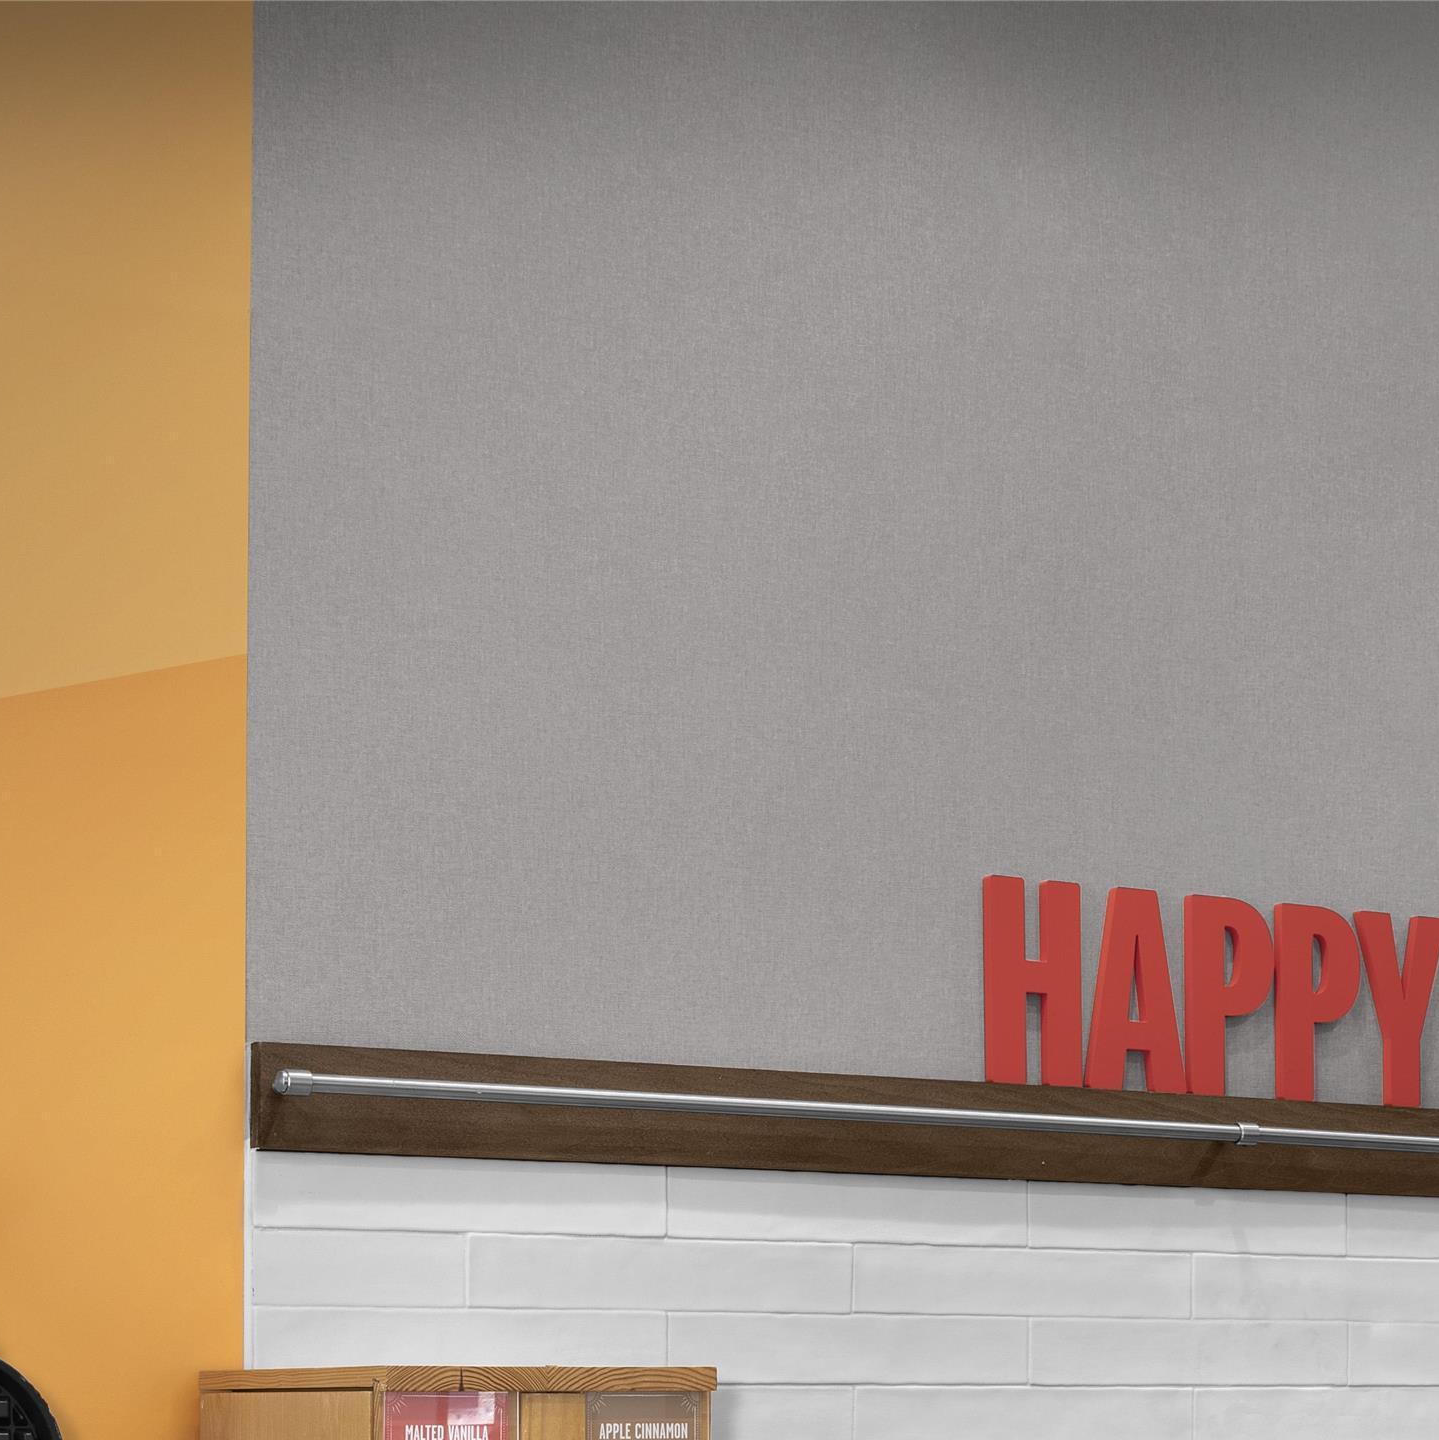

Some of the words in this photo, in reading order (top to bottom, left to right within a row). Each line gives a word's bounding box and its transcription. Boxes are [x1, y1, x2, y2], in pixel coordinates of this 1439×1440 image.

[405, 1425, 444, 1440] MALTED
[448, 1425, 488, 1440] VANILLA
[599, 1423, 631, 1439] APPLE
[635, 1422, 688, 1439] CINNAMON
